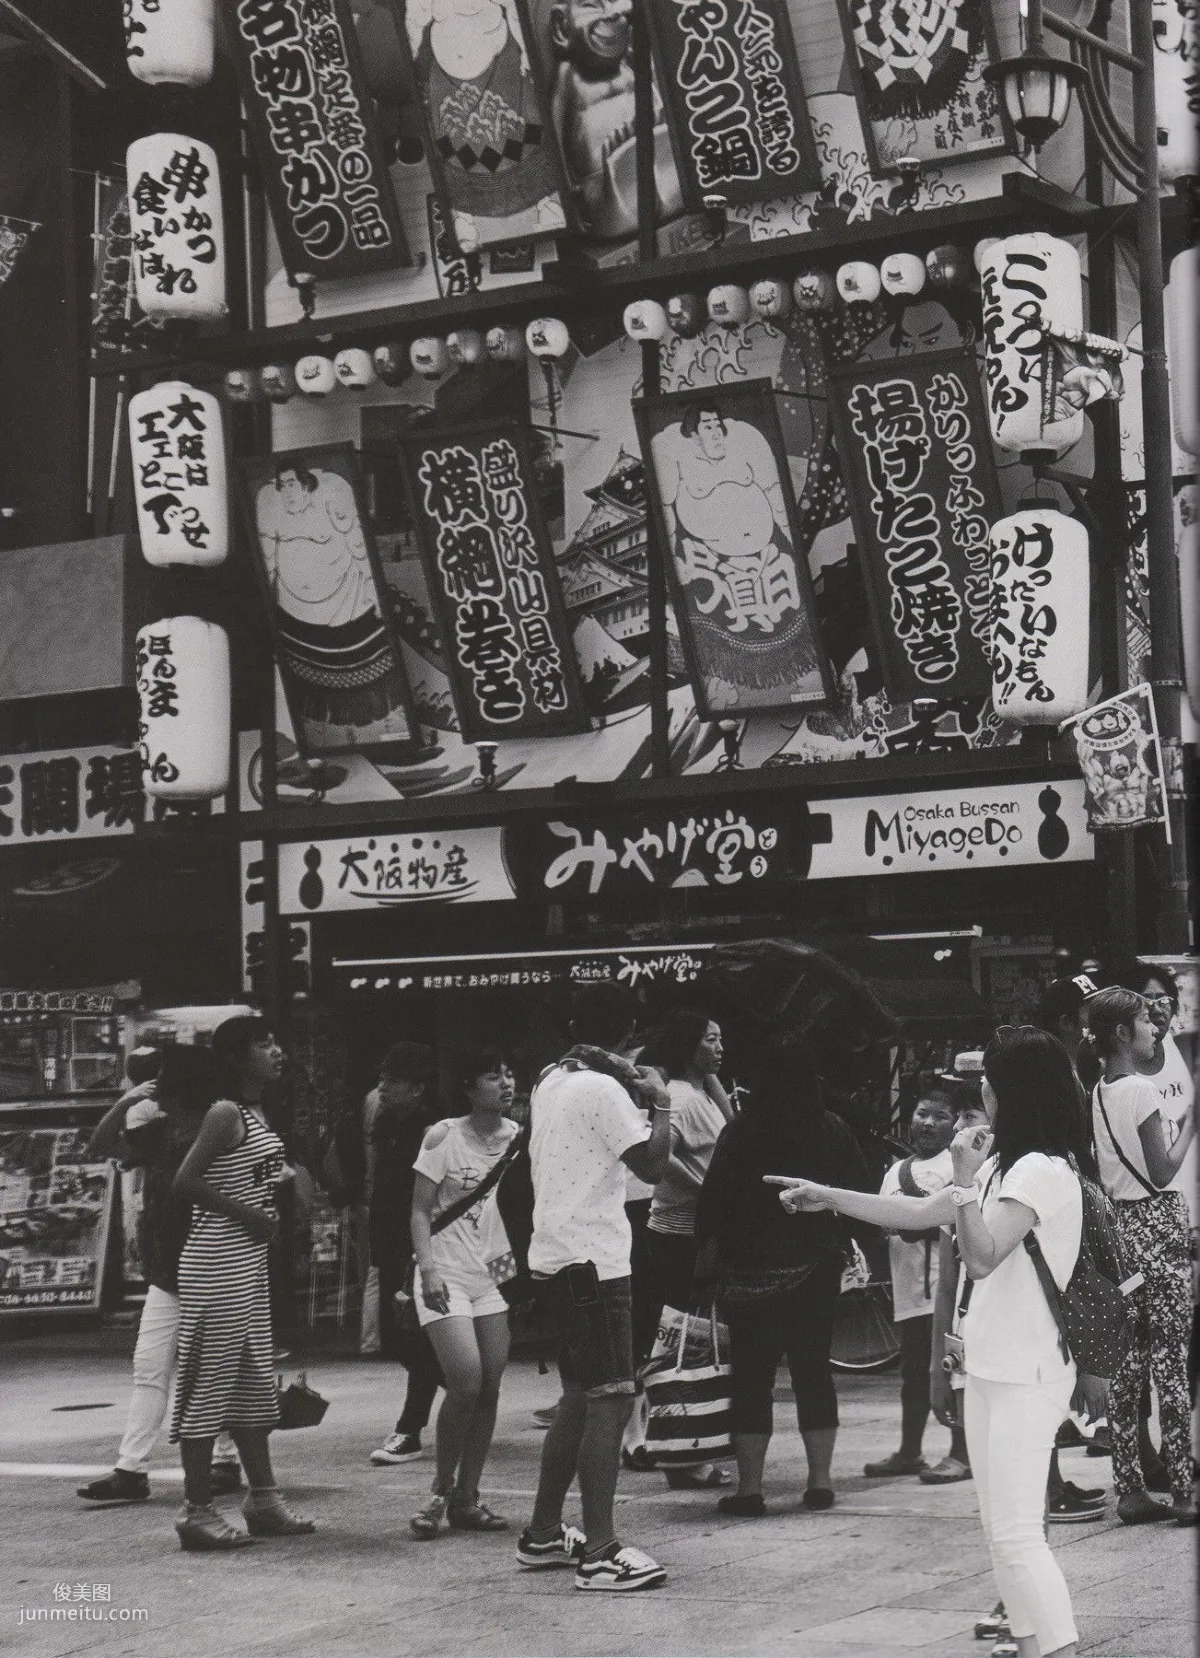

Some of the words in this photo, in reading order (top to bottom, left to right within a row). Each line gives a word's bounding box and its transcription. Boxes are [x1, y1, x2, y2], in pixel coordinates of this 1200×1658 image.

[161, 146, 216, 263] 串かつ
[848, 378, 963, 684] 揚げたこ焼き
[864, 808, 1023, 857] MiyageDo
[903, 803, 954, 822] Osaka
[958, 799, 1020, 818] Bussan
[338, 844, 468, 890] 大阪物産
[544, 809, 753, 894] みやげ堂
